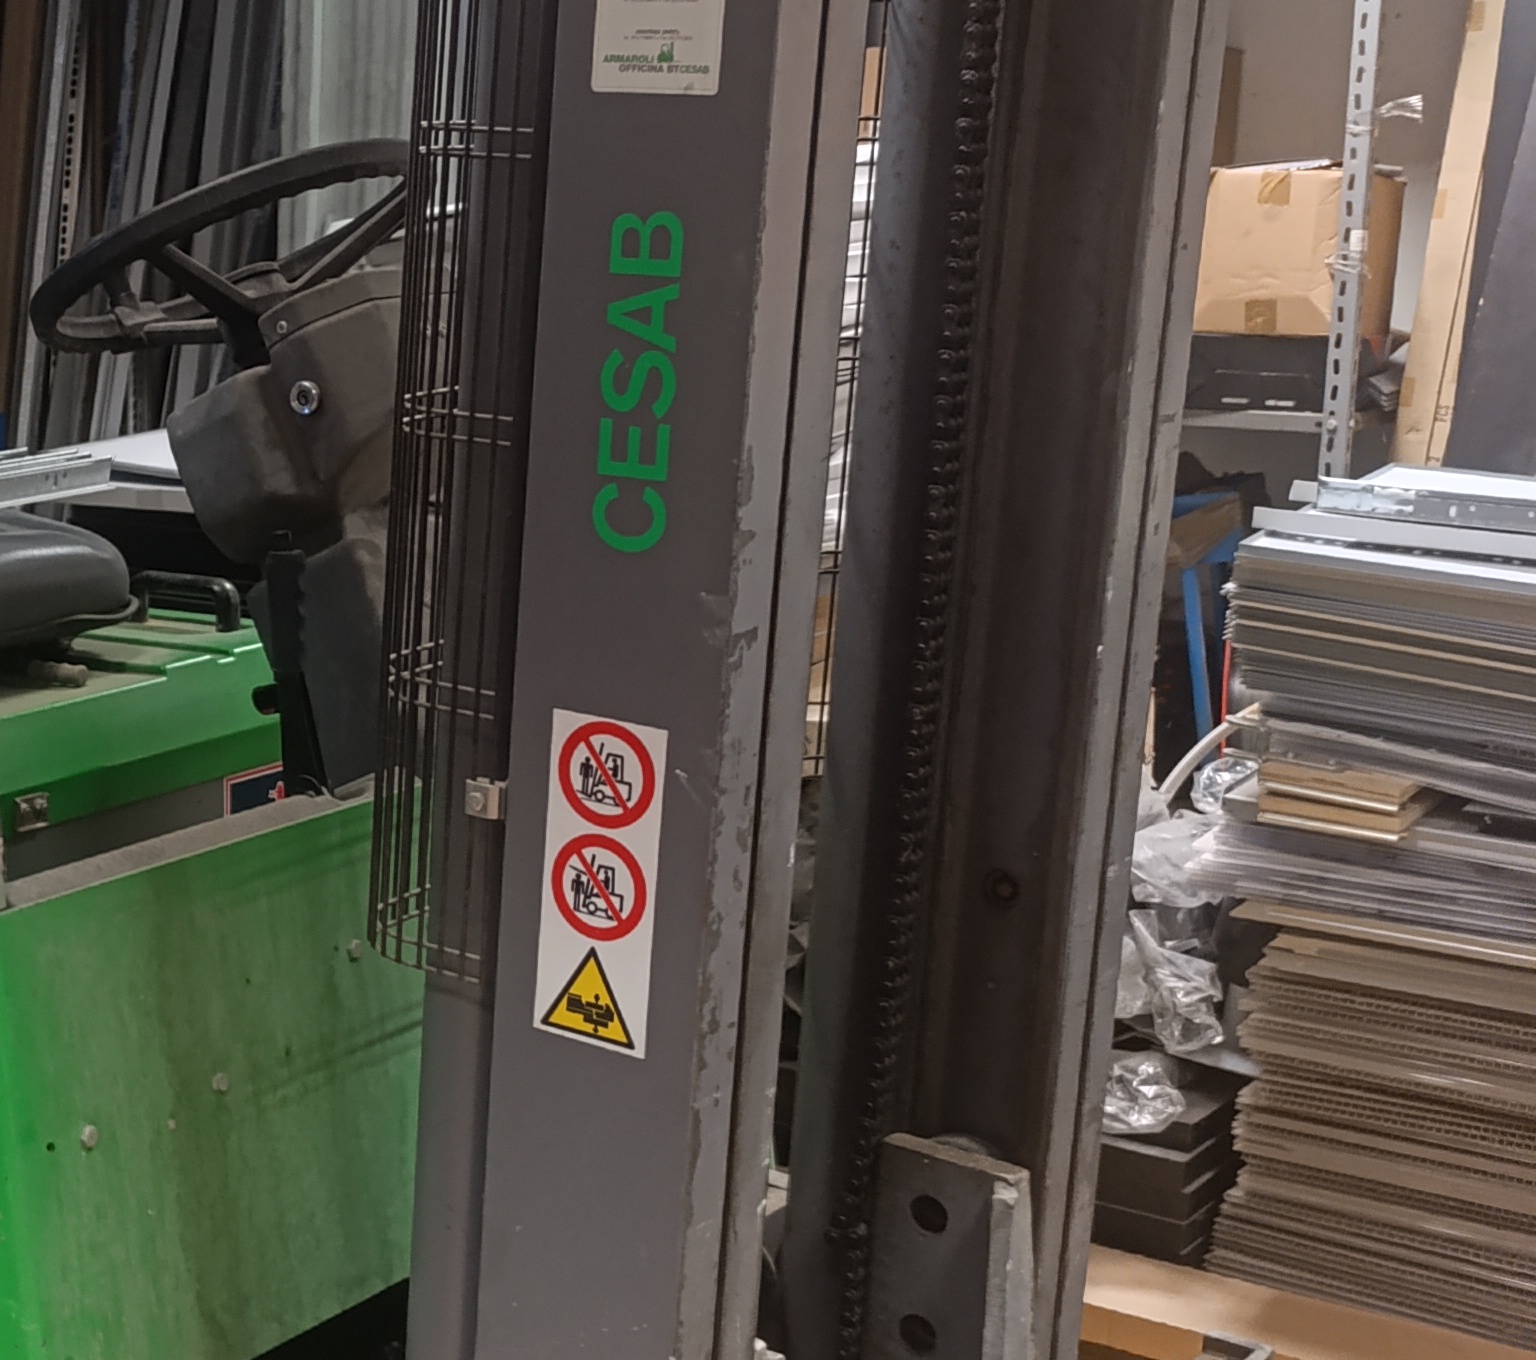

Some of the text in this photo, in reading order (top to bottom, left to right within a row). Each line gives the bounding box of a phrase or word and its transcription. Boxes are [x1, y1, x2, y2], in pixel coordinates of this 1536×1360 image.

[603, 54, 654, 63] ARMAROLI
[618, 64, 710, 74] OFFICINA BTCESAB
[592, 211, 684, 553] CESAB
